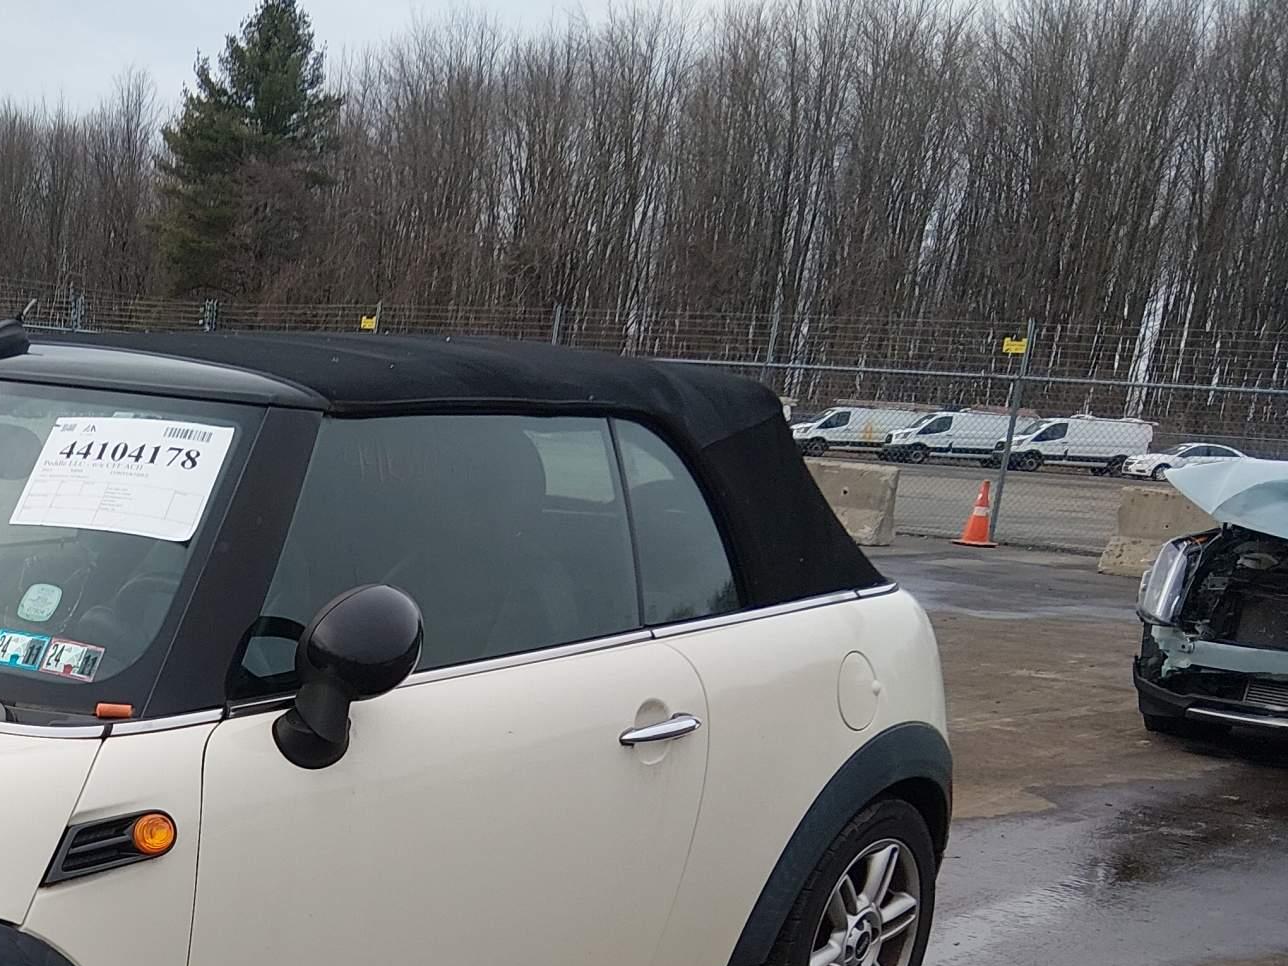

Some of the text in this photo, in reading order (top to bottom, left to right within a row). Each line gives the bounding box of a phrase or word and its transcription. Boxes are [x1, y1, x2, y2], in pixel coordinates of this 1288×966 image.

[59, 440, 201, 470] 44104178
[23, 645, 44, 665] 11
[46, 643, 99, 676] 24 11
